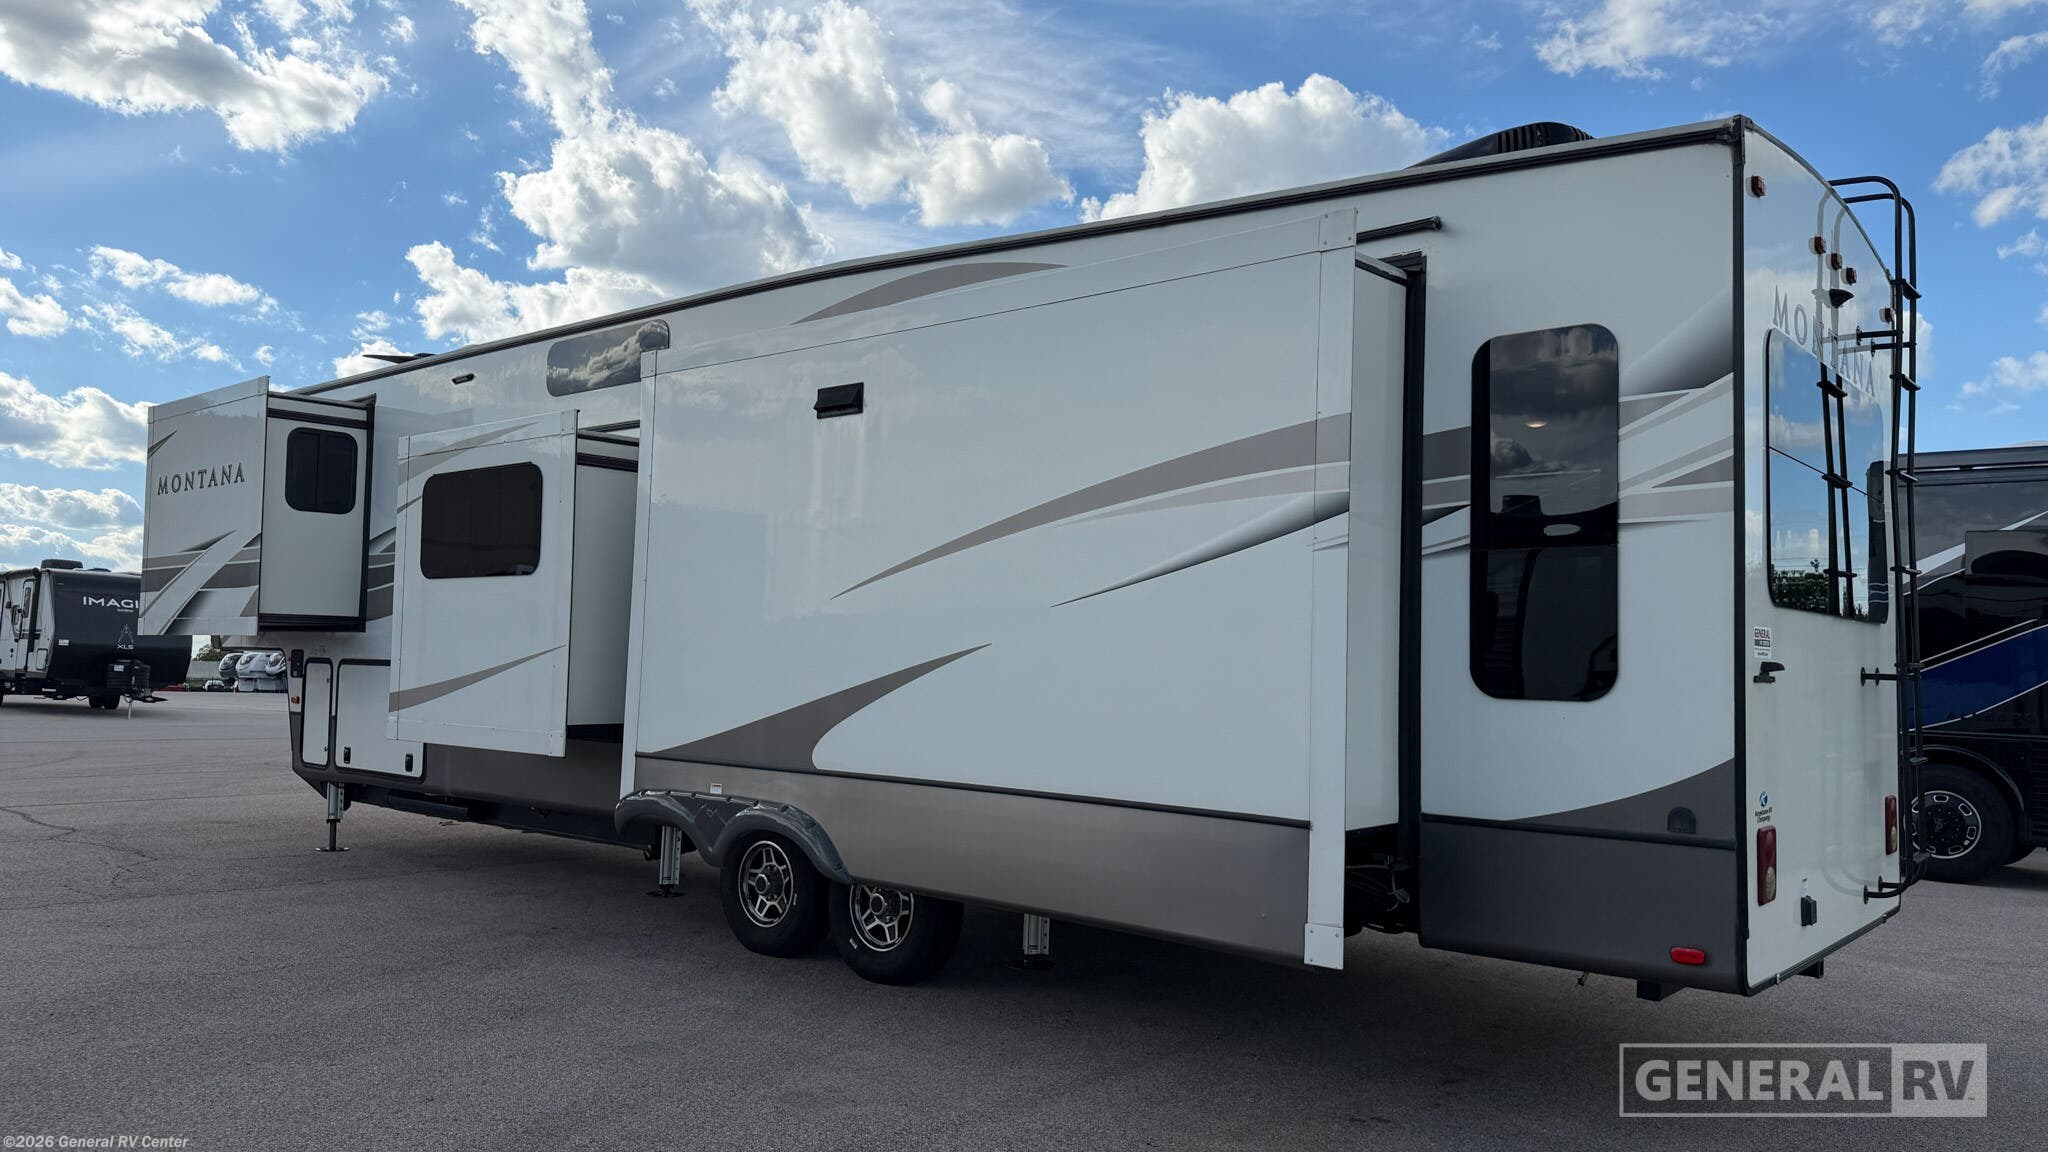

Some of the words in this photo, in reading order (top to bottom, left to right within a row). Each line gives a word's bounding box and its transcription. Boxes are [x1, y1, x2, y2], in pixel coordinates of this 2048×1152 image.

[1773, 284, 1876, 398] MONTANA
[157, 462, 245, 495] MONTANA
[83, 596, 139, 608] IMAGI
